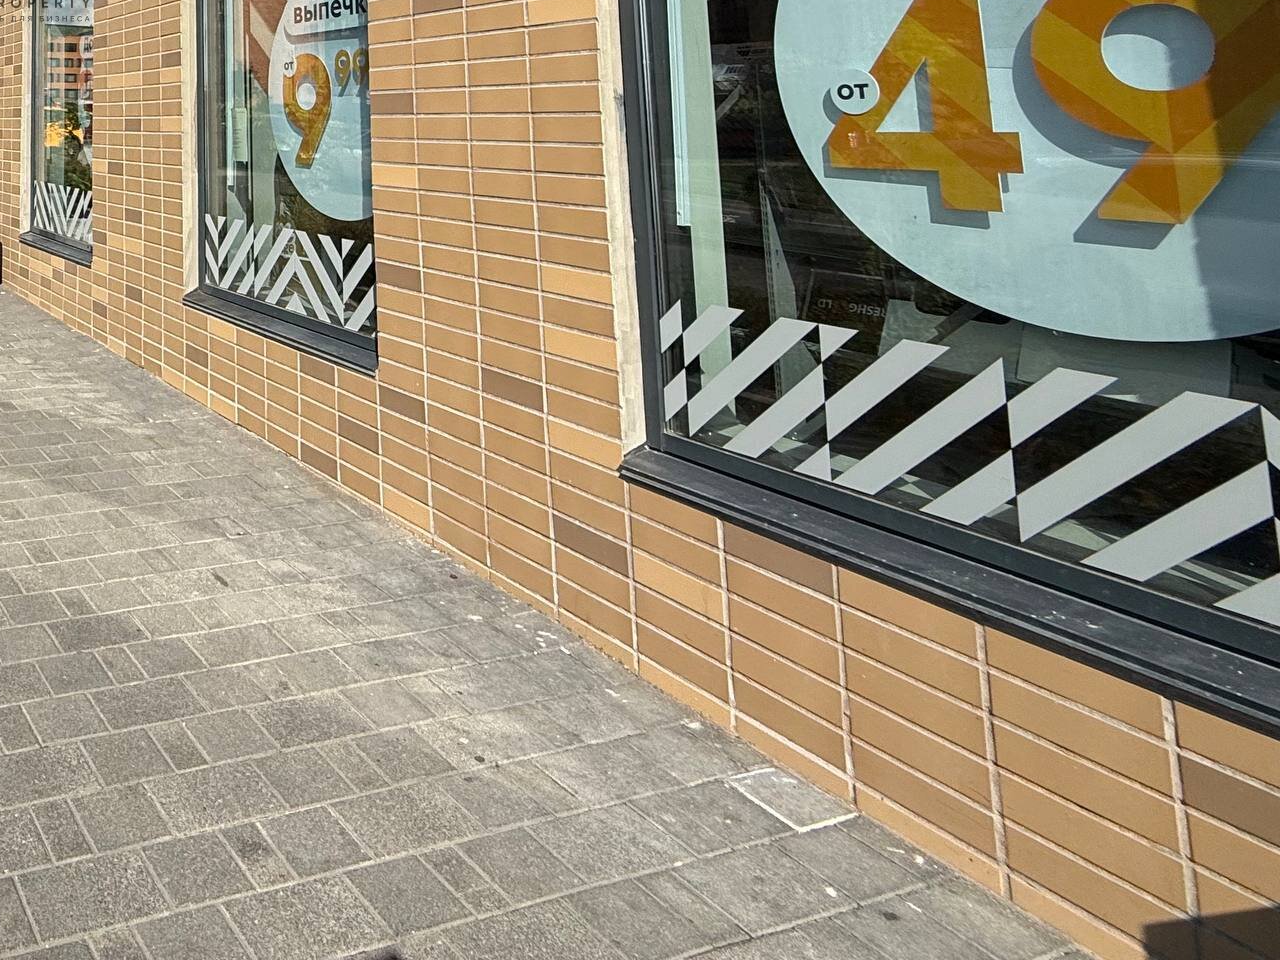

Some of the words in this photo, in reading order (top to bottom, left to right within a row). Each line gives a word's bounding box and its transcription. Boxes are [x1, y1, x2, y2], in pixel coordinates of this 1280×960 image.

[283, 61, 294, 71] от
[837, 82, 869, 101] от
[282, 52, 331, 163] 9
